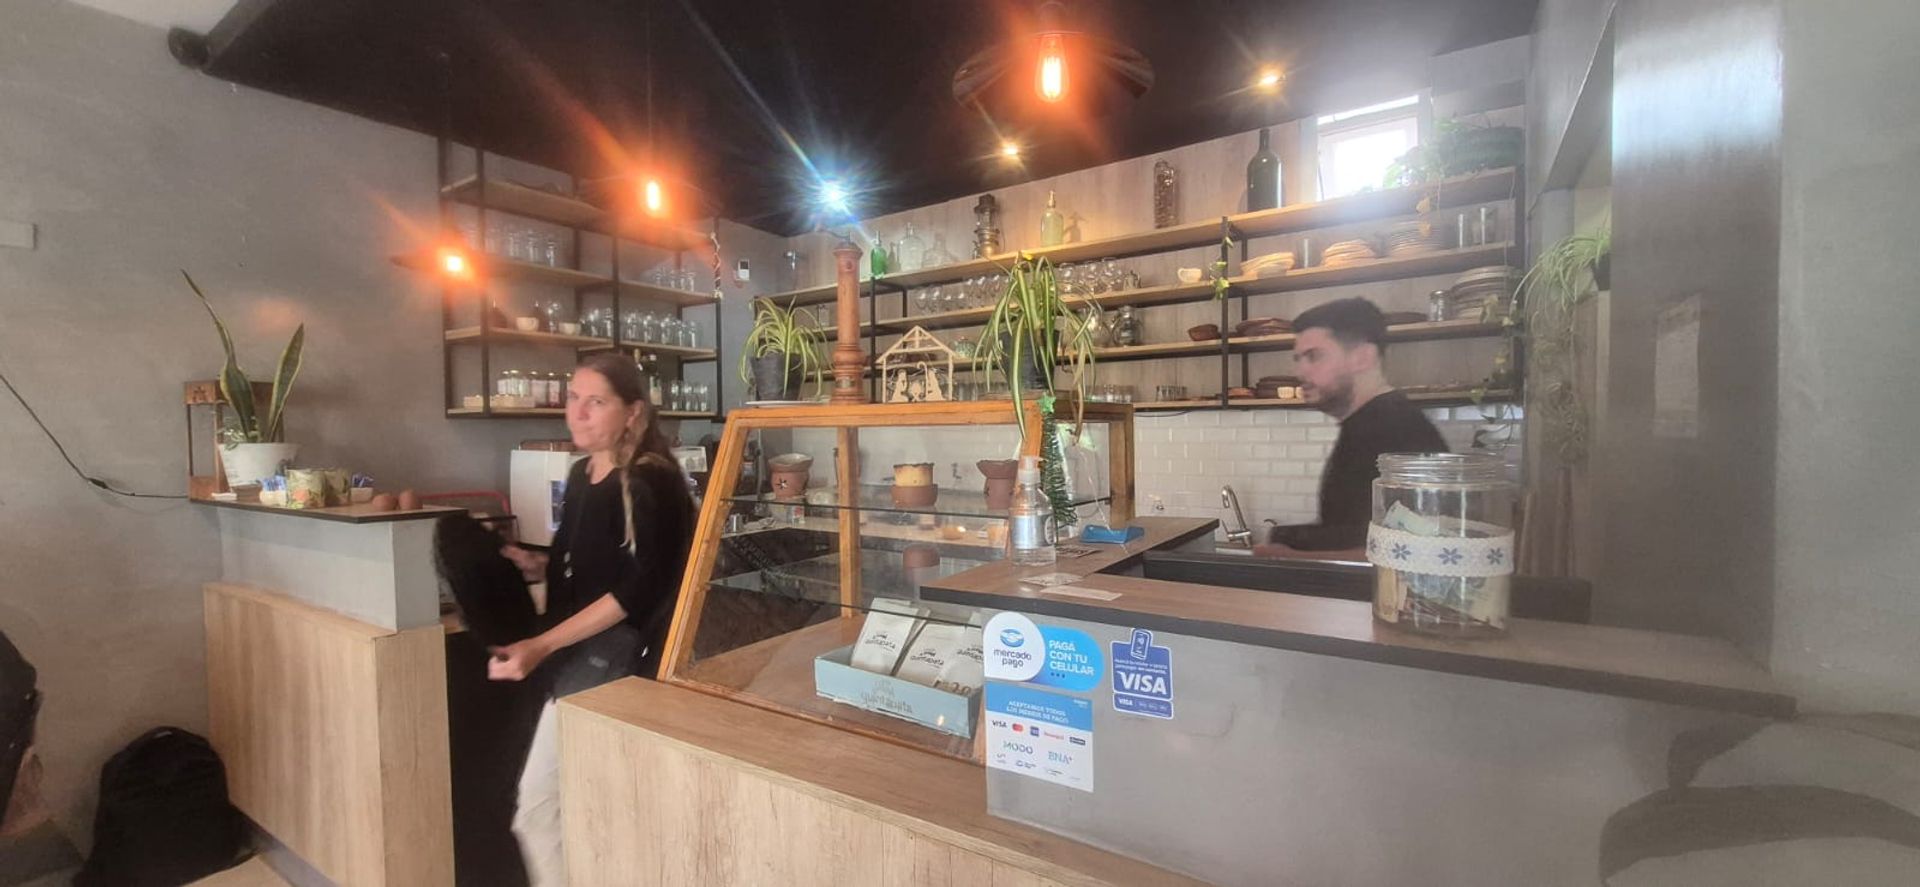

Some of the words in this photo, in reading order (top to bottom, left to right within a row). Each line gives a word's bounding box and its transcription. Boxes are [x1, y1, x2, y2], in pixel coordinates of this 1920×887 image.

[993, 648, 1032, 661] mercado
[1049, 650, 1072, 661] CON
[1073, 653, 1087, 664] TU
[1002, 657, 1024, 668] pago
[1049, 660, 1095, 676] CELULAR
[1116, 671, 1167, 695] VISA
[992, 720, 1007, 728] VISA
